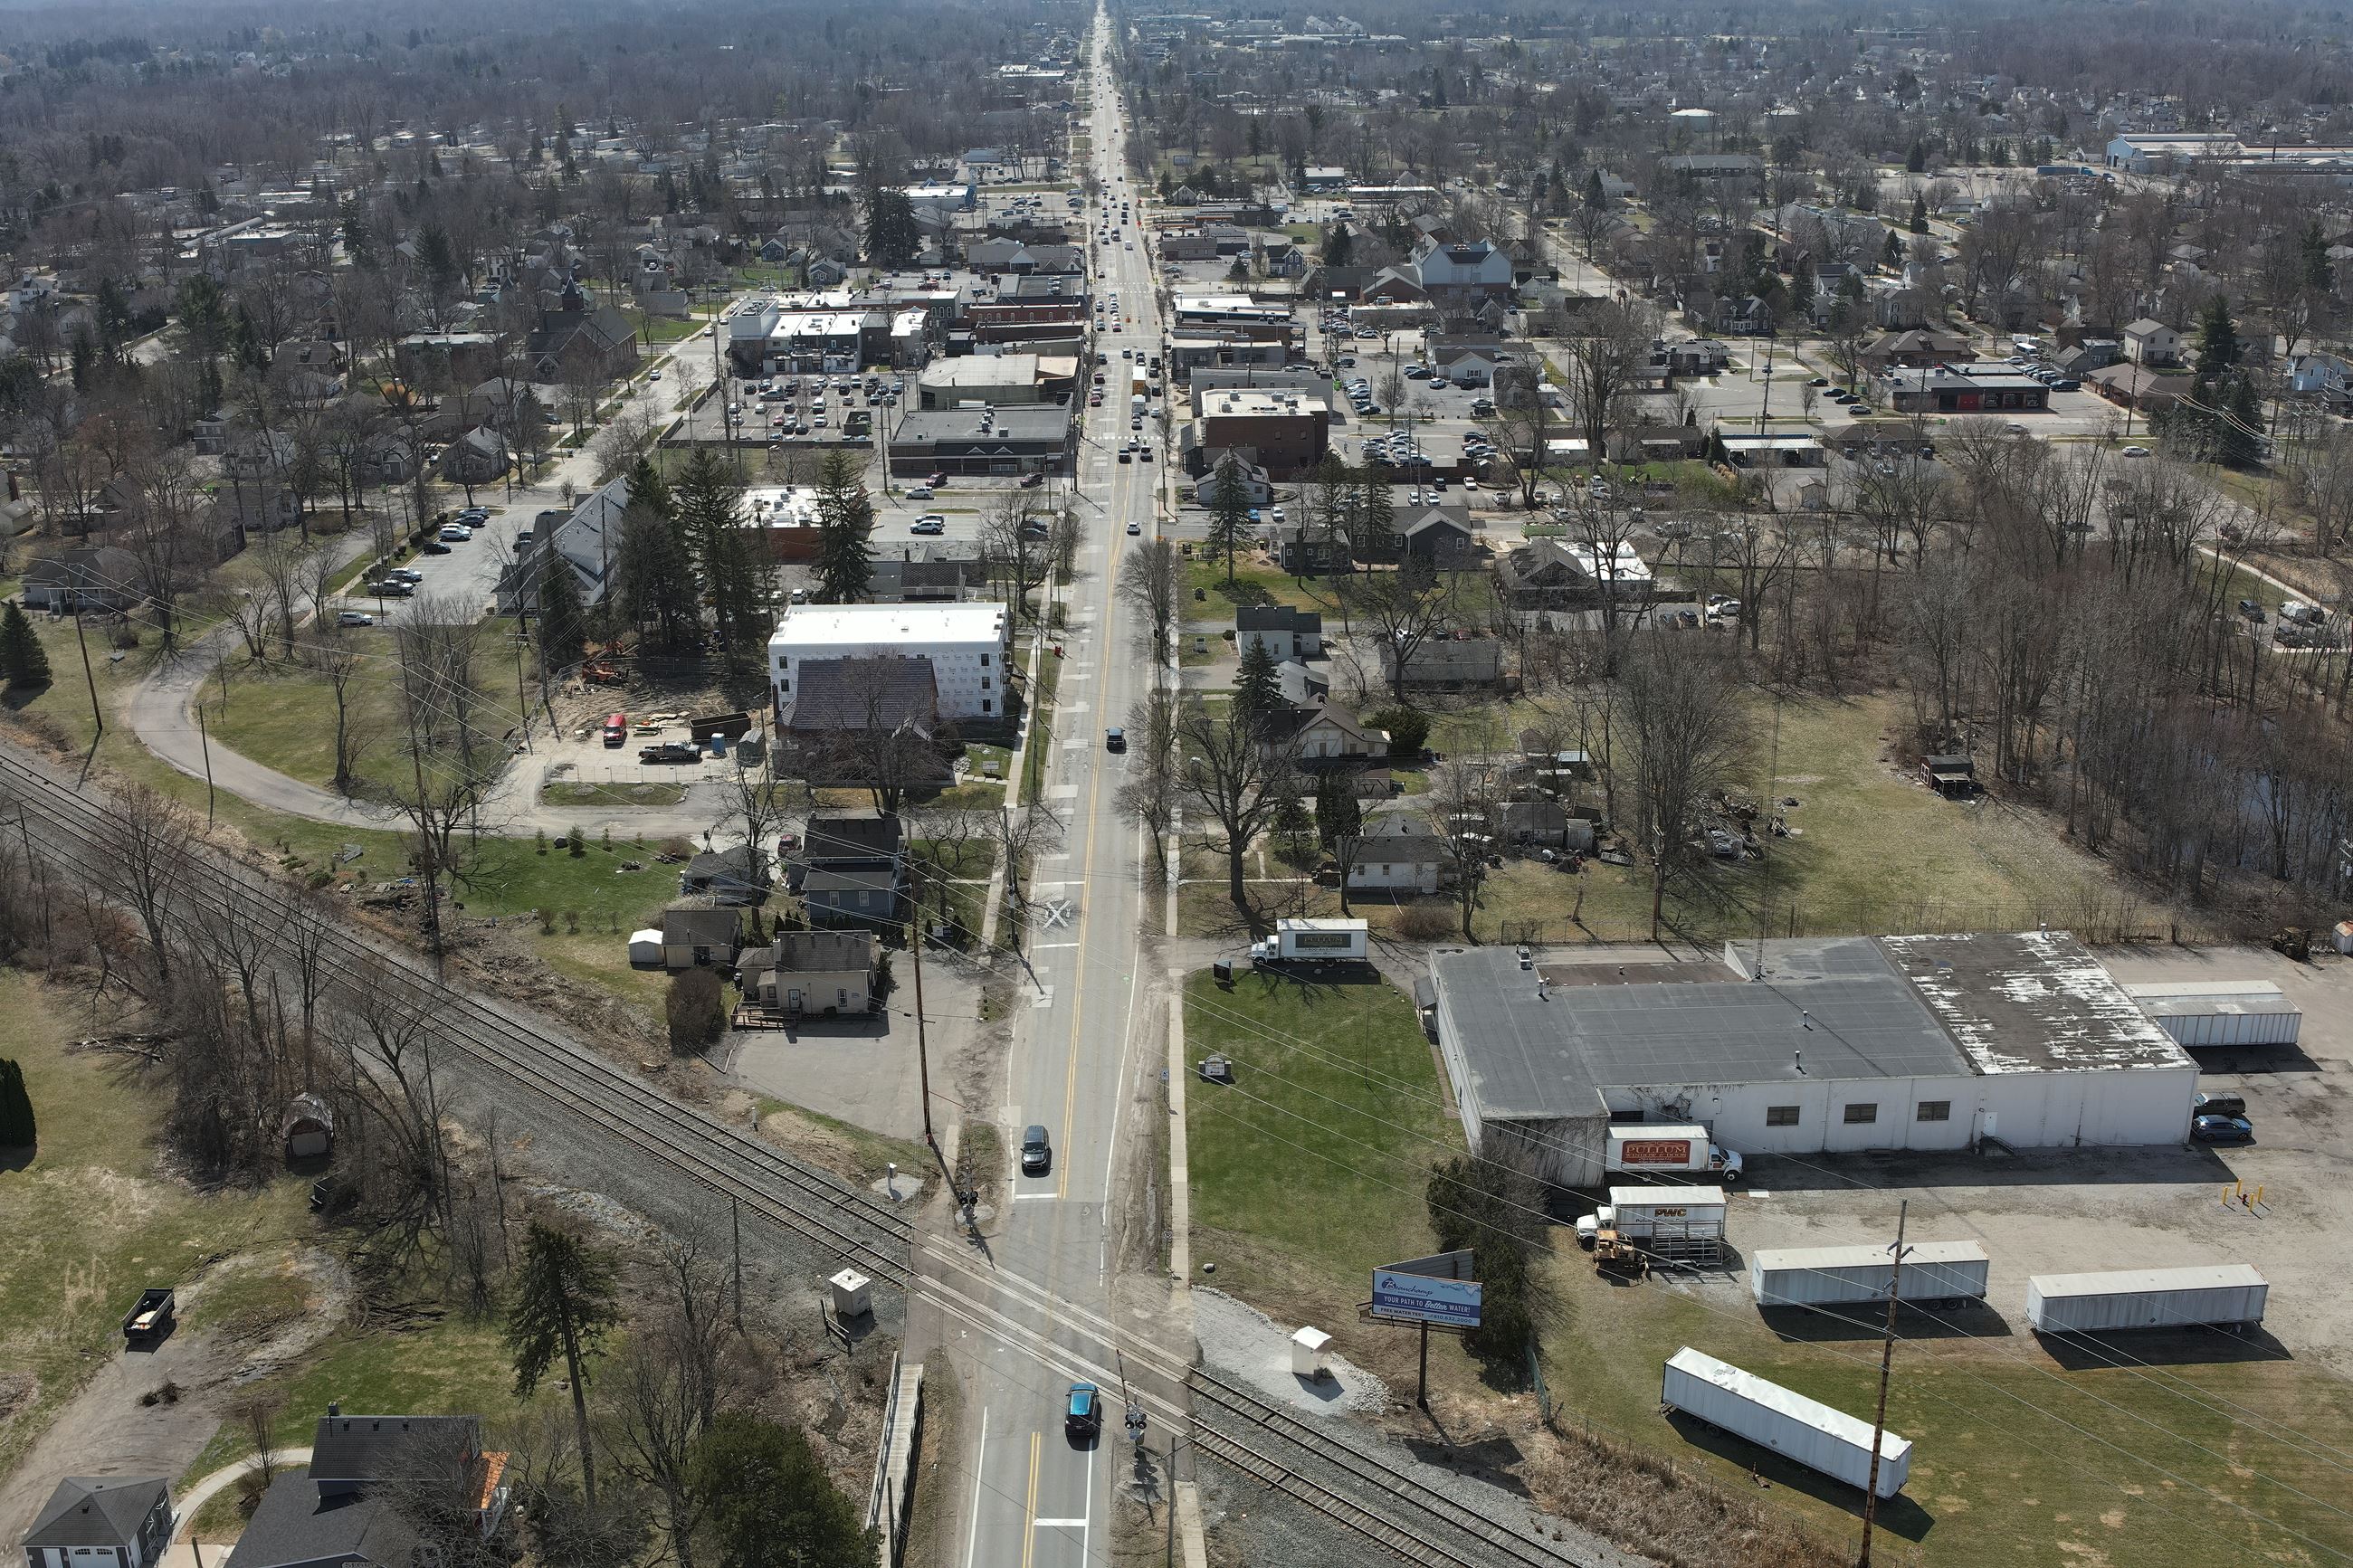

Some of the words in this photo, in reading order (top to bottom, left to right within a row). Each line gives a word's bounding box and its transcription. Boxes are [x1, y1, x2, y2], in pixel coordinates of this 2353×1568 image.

[1654, 1208, 1687, 1217] PWC
[1385, 1280, 1433, 1297] Beauchamp
[1384, 1296, 1399, 1304] YOUR
[1400, 1297, 1415, 1306] PATH
[1416, 1299, 1424, 1307] TO
[1424, 1300, 1448, 1310] Better
[1449, 1304, 1471, 1313] WATER!
